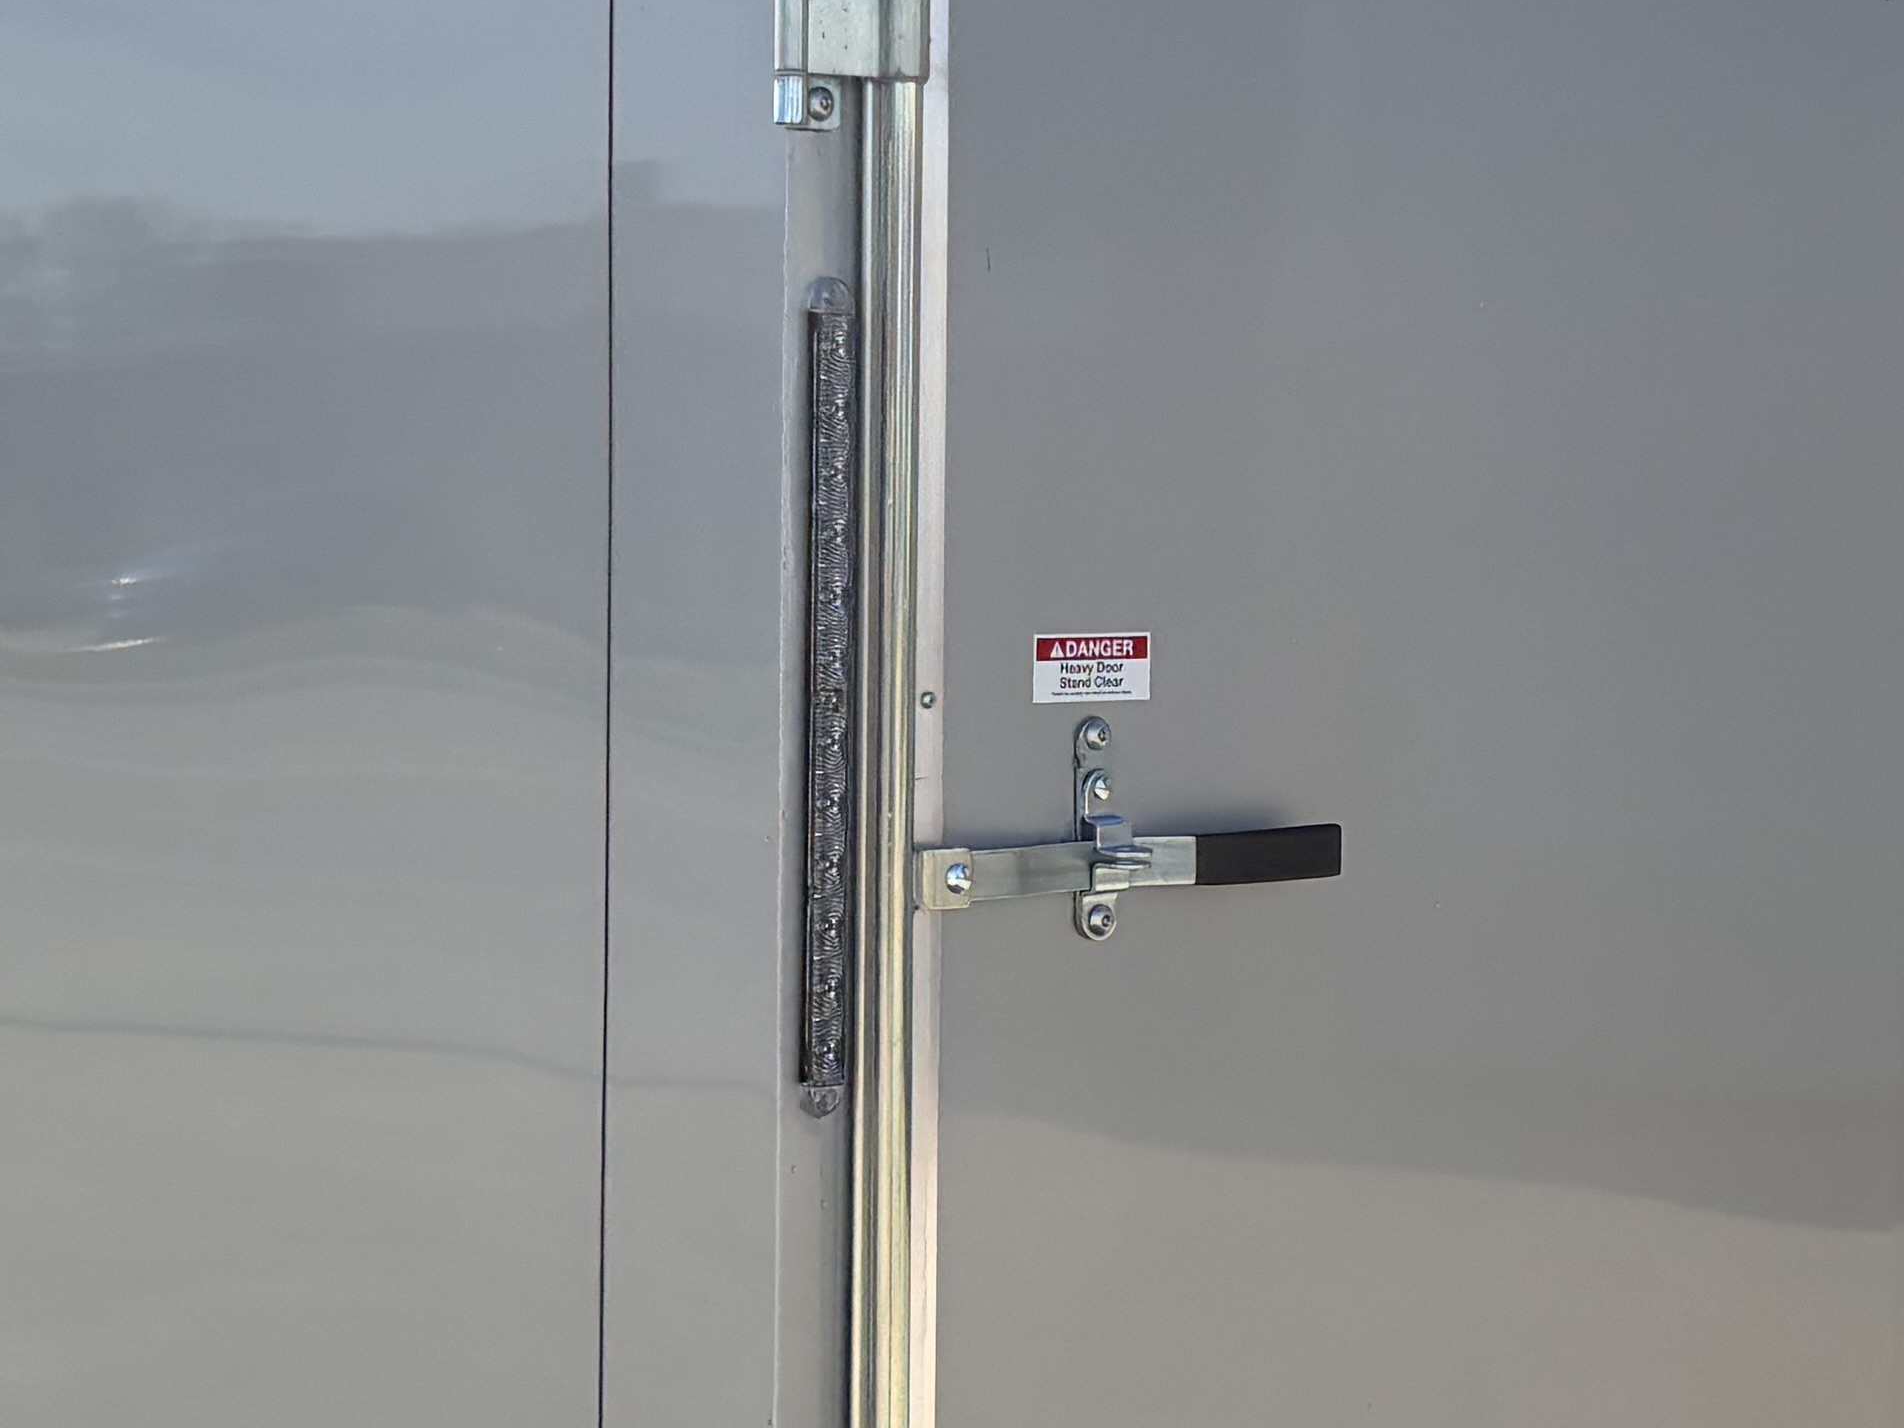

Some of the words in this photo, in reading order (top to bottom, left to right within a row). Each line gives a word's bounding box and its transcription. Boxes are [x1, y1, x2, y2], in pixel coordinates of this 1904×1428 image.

[1066, 639, 1133, 657] DANGER
[1060, 662, 1093, 676] Heavy
[1096, 661, 1123, 673] Door
[1060, 677, 1091, 689] Stand
[1095, 676, 1124, 688] Clear
